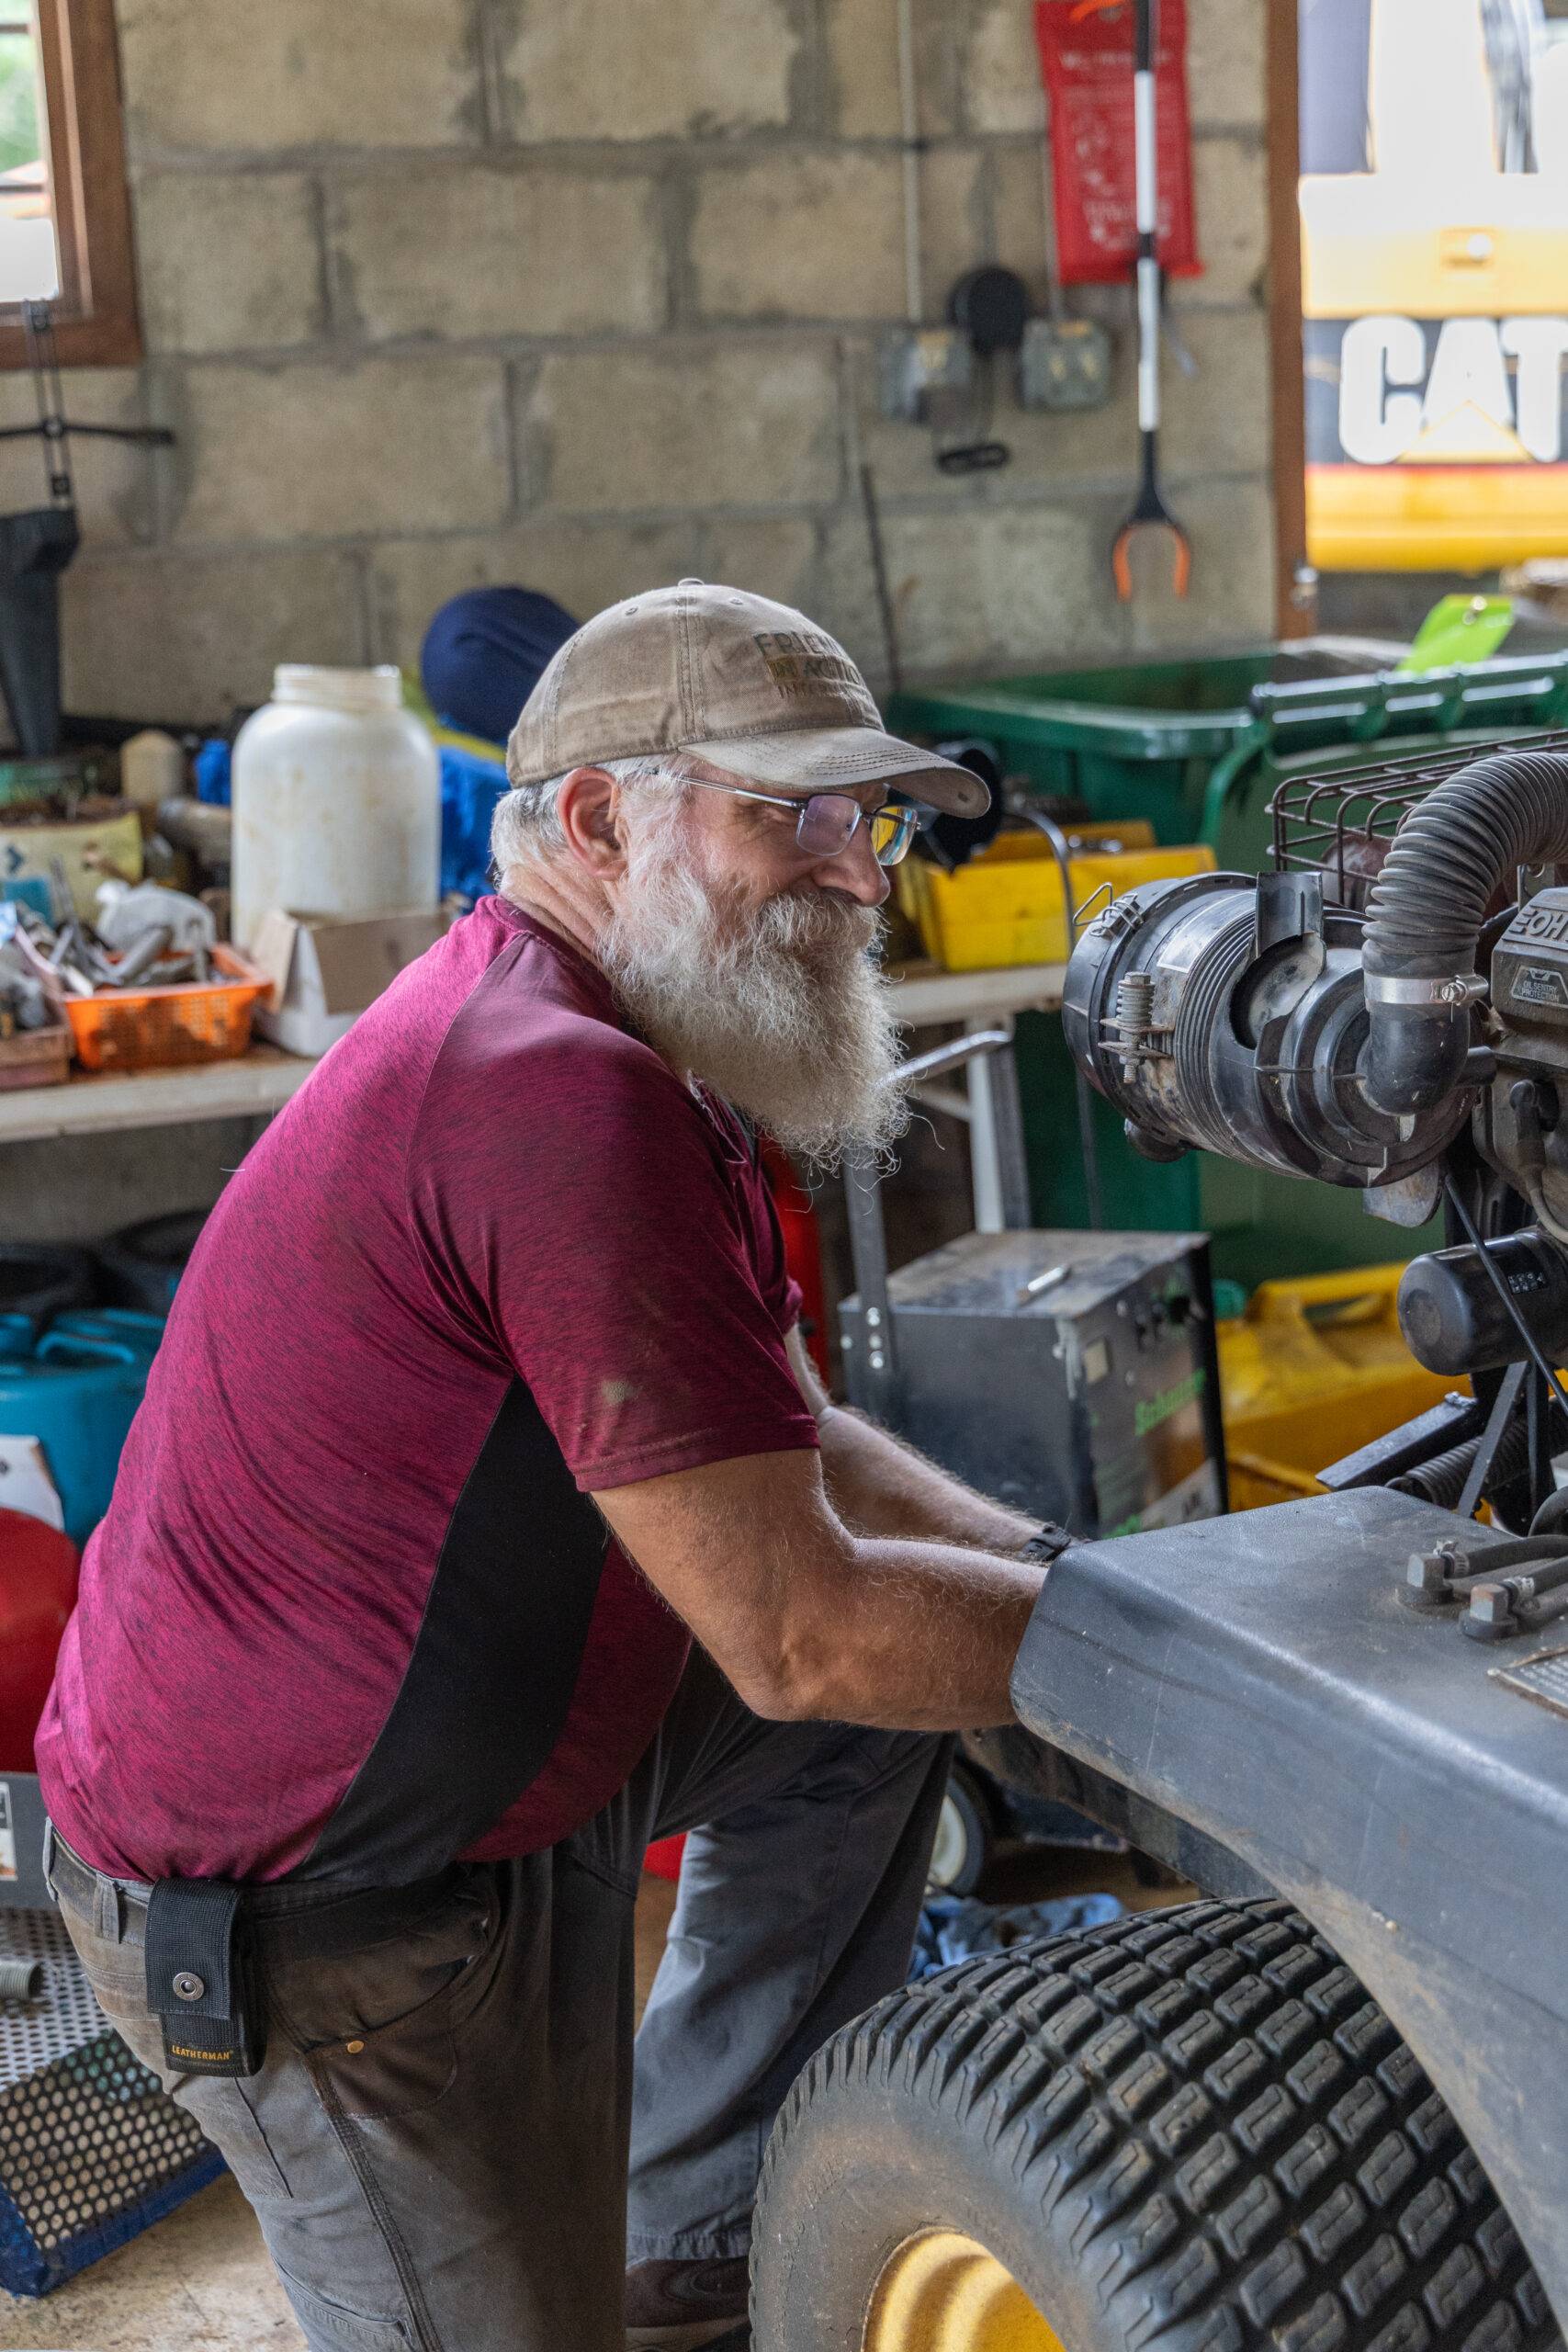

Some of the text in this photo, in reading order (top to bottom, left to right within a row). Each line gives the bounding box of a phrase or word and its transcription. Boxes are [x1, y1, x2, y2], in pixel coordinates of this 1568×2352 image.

[1338, 315, 1568, 465] CAT
[1521, 987, 1560, 1002] PROTECTION
[1533, 982, 1558, 994] SENTRY
[172, 2044, 230, 2060] LEATHERMAN
